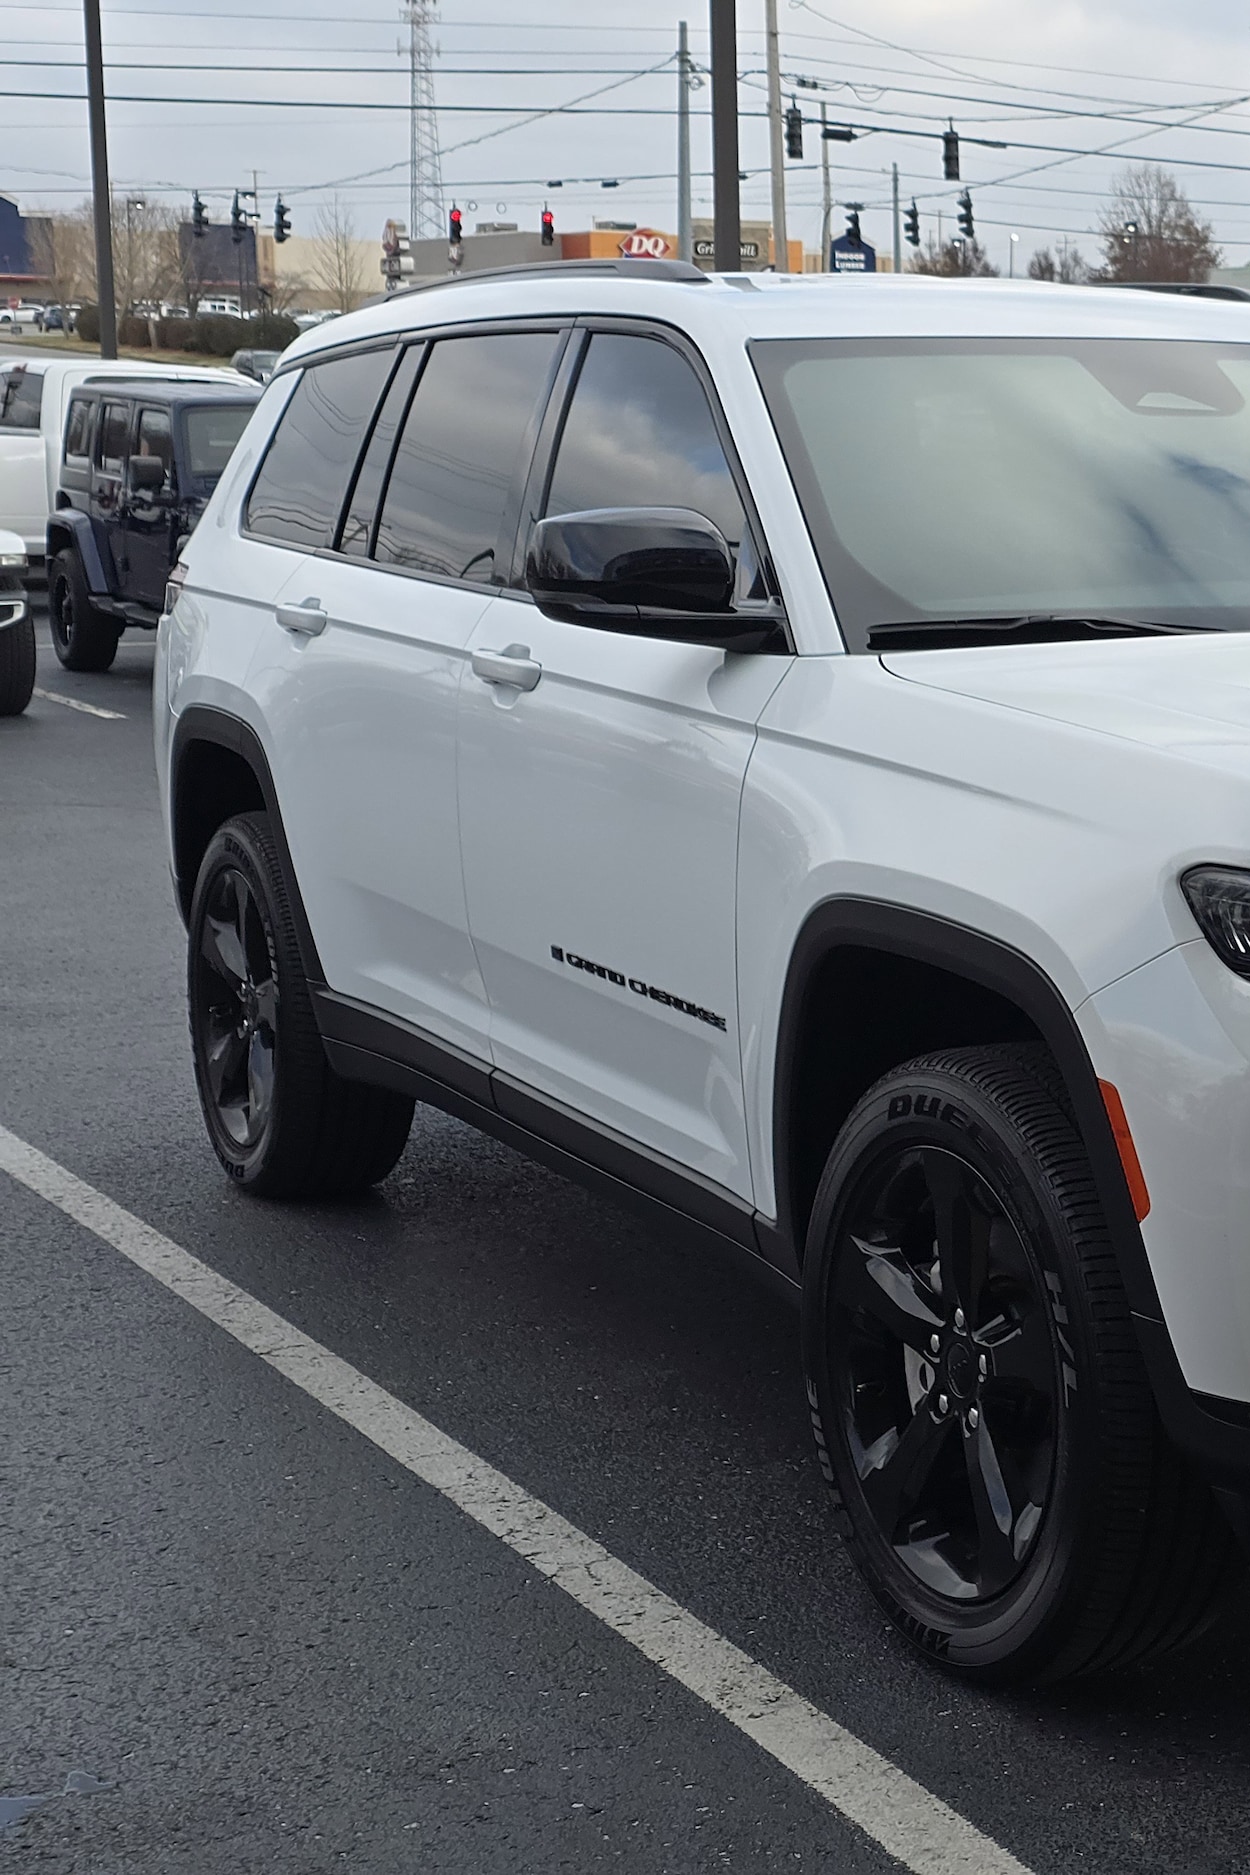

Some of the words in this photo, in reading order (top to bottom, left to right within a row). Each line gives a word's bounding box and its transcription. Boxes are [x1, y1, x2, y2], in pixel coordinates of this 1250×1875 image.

[630, 235, 665, 258] DQ
[696, 242, 715, 255] Gri
[566, 952, 626, 987] GRAND
[628, 977, 728, 1033] CHEROKEE
